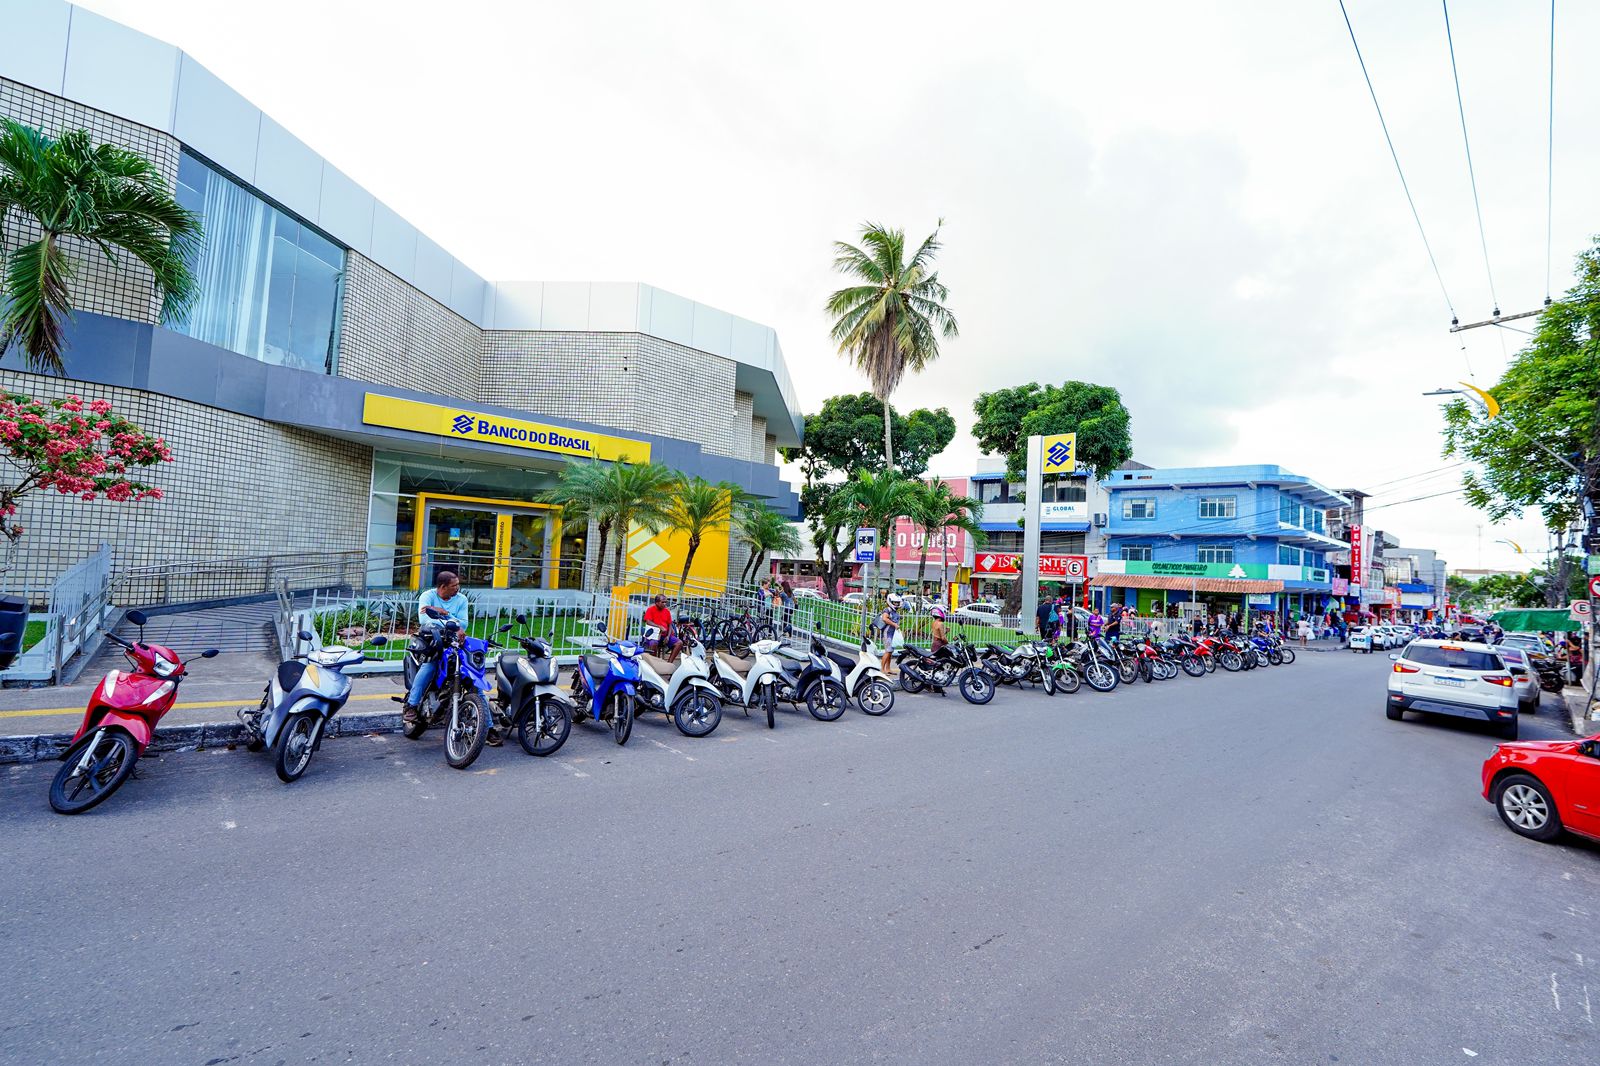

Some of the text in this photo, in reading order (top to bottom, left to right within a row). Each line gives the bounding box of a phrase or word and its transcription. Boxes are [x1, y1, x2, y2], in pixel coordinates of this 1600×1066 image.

[478, 420, 591, 451] BANCO DO BRASIL
[1353, 525, 1361, 582] DENTISTA
[1072, 563, 1078, 573] E
[1579, 604, 1587, 612] E
